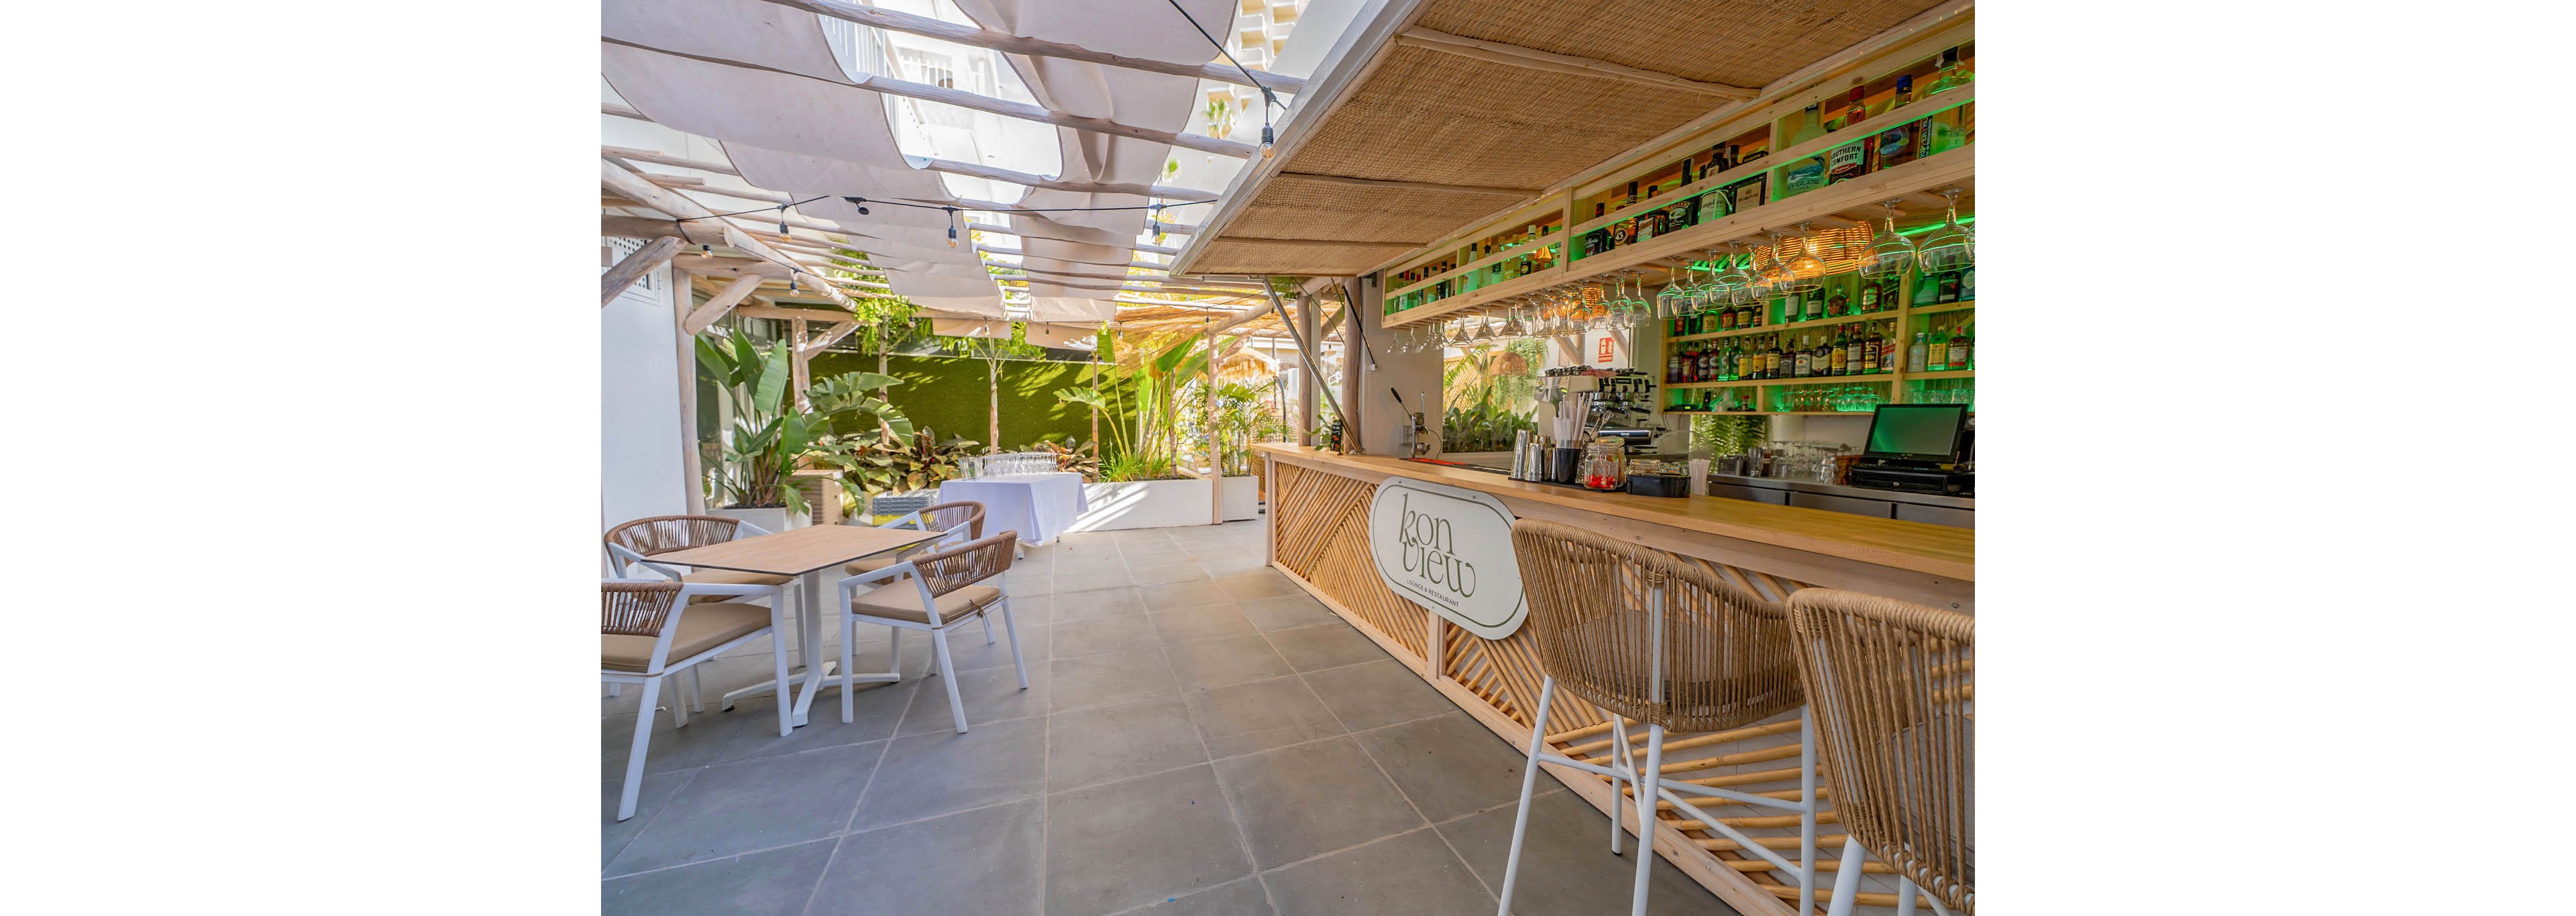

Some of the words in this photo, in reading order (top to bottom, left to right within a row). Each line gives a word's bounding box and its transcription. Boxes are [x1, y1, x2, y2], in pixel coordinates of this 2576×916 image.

[1831, 146, 1862, 160] SOUTHERN
[1831, 153, 1859, 167] COMFORT
[1615, 231, 1623, 240] 43
[1399, 493, 1456, 556] kon
[1402, 536, 1477, 599] view
[1407, 579, 1424, 591] LOUNGE
[1428, 589, 1459, 607] RESTAURANT
